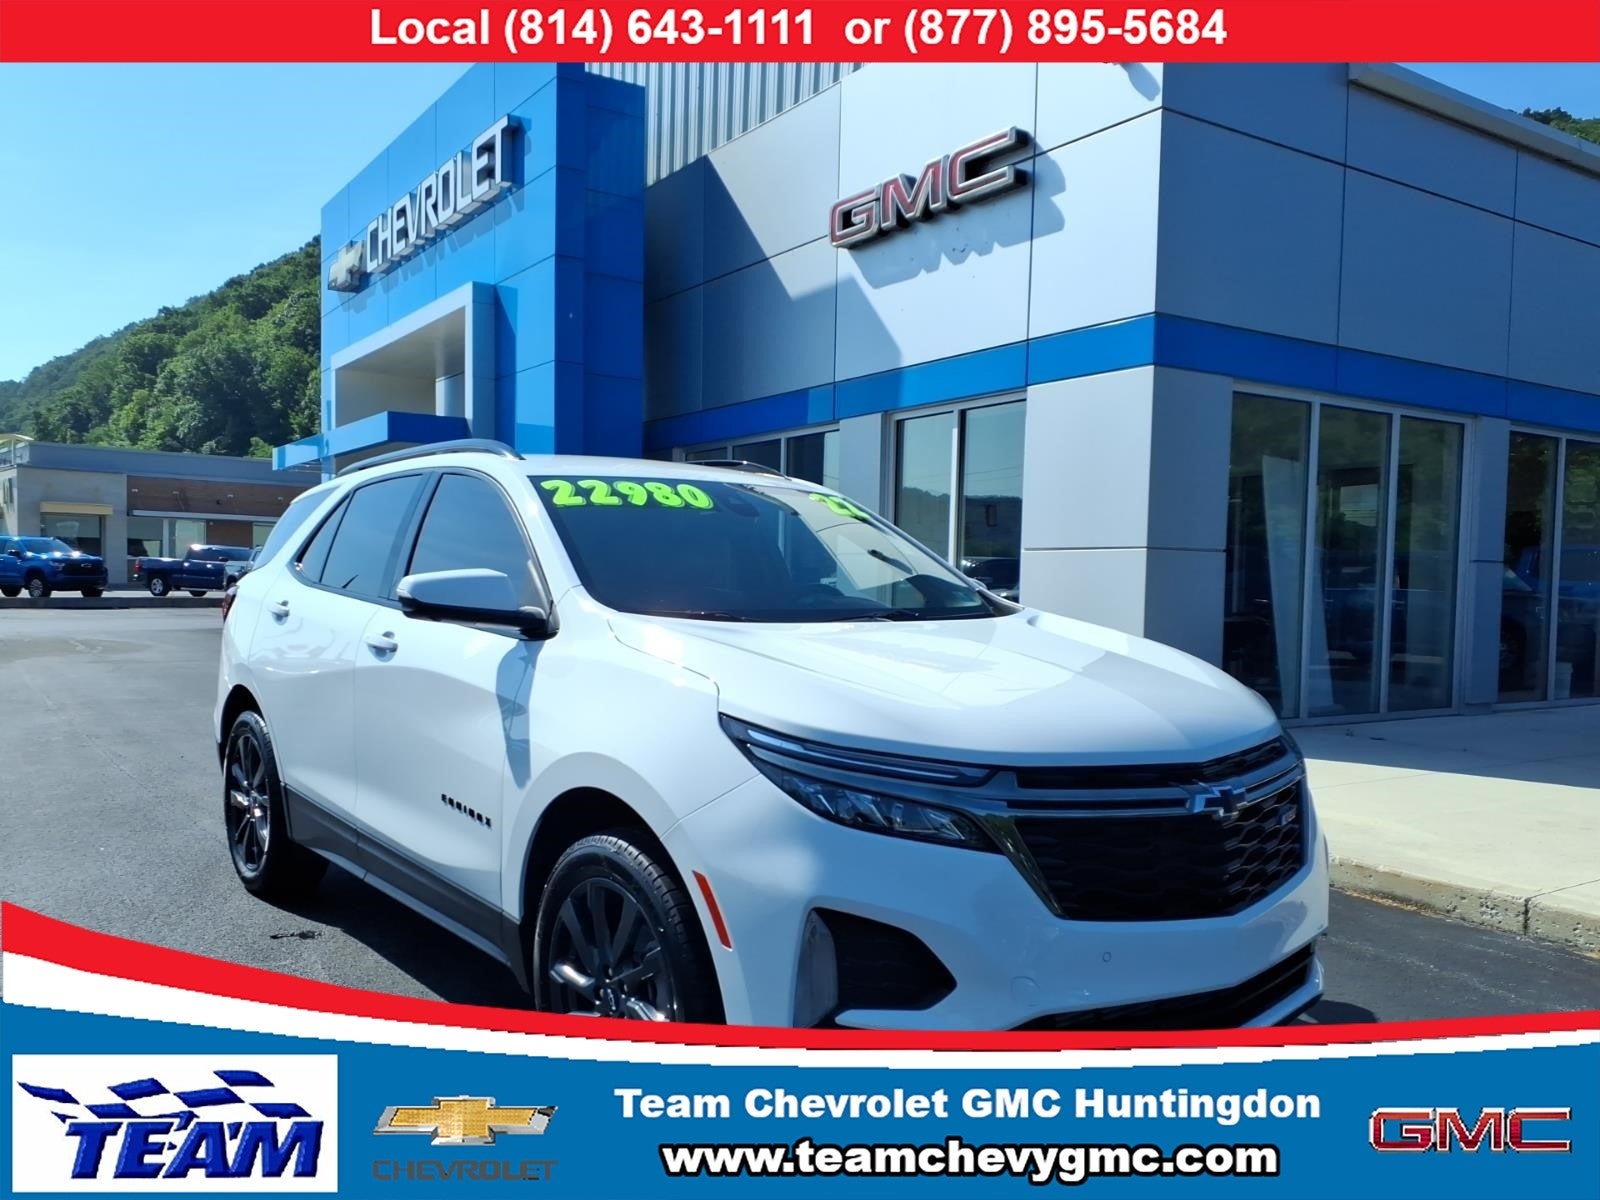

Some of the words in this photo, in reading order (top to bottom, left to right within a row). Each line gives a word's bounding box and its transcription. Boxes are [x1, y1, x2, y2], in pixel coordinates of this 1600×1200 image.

[366, 114, 510, 273] CHEVROLET
[830, 126, 1022, 248] GMC
[540, 479, 714, 509] 22980
